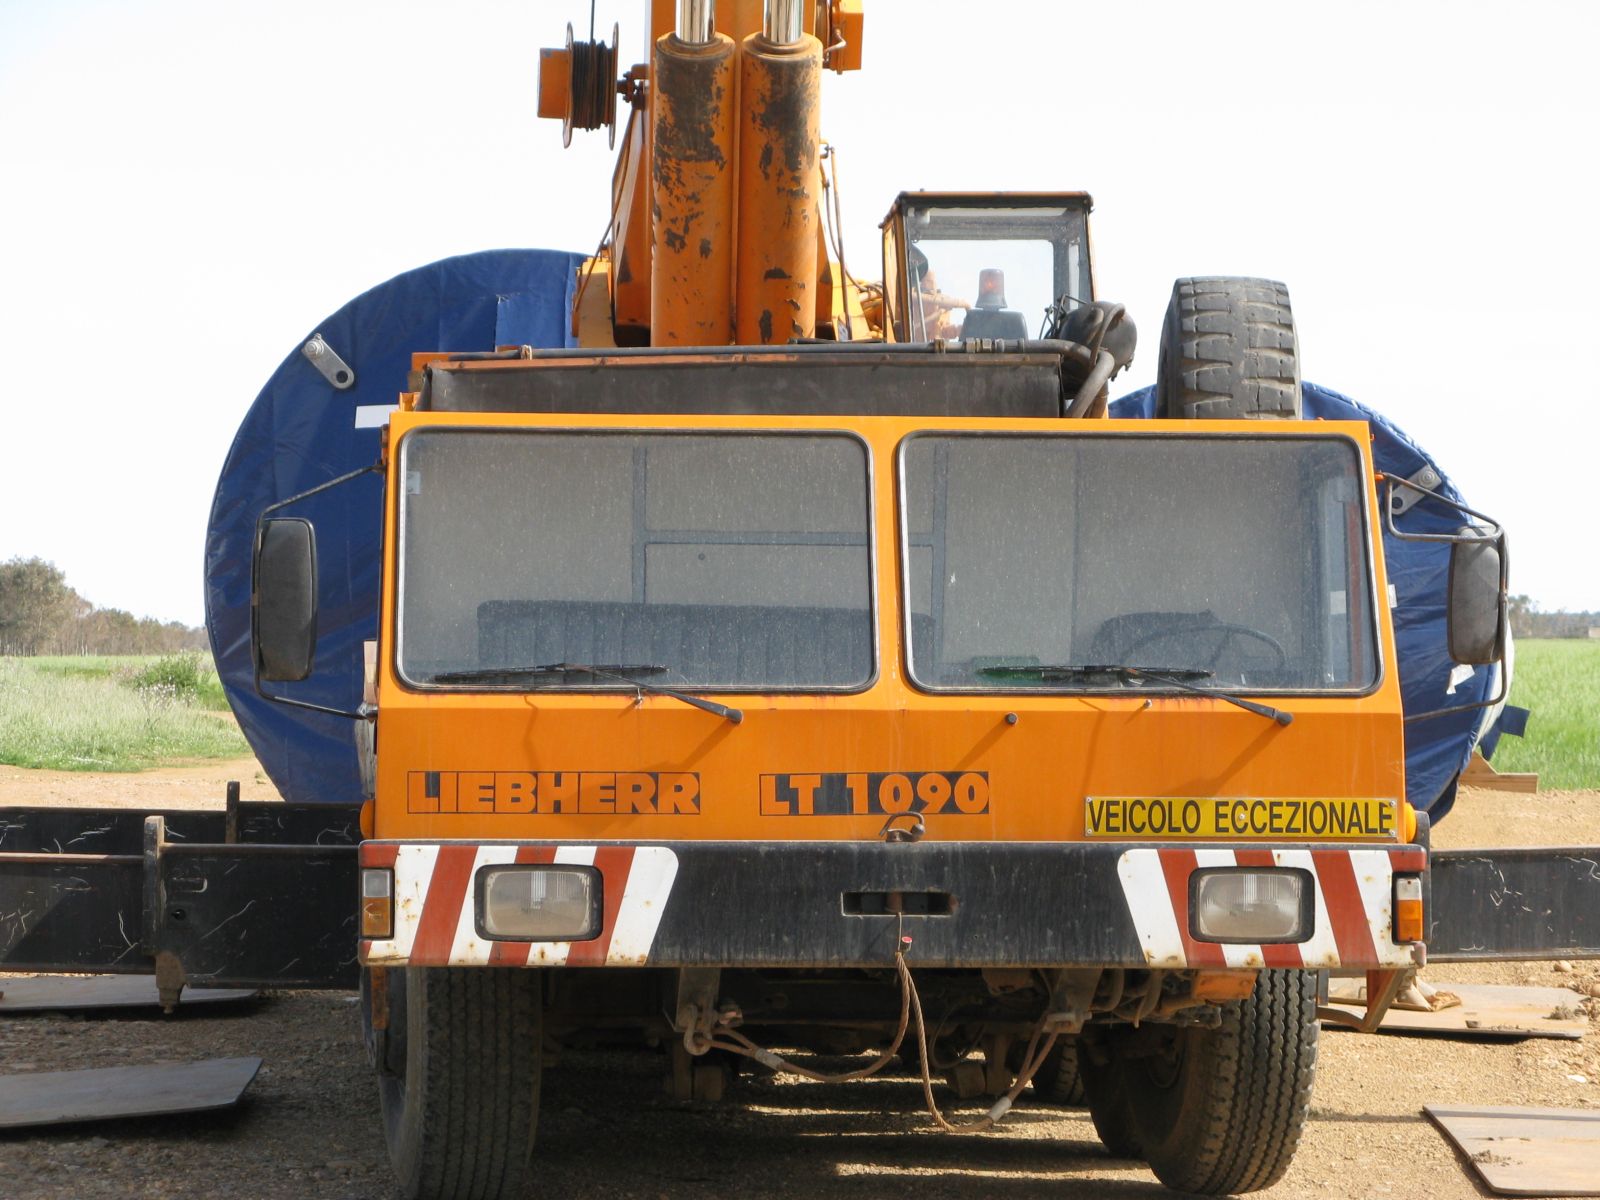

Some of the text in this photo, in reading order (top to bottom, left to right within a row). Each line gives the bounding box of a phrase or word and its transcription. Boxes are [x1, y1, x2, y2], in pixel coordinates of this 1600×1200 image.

[408, 771, 700, 815] LIEBHERR
[760, 772, 989, 815] LT 1090
[1089, 799, 1393, 834] VEICOLO ECCEZIONALE
